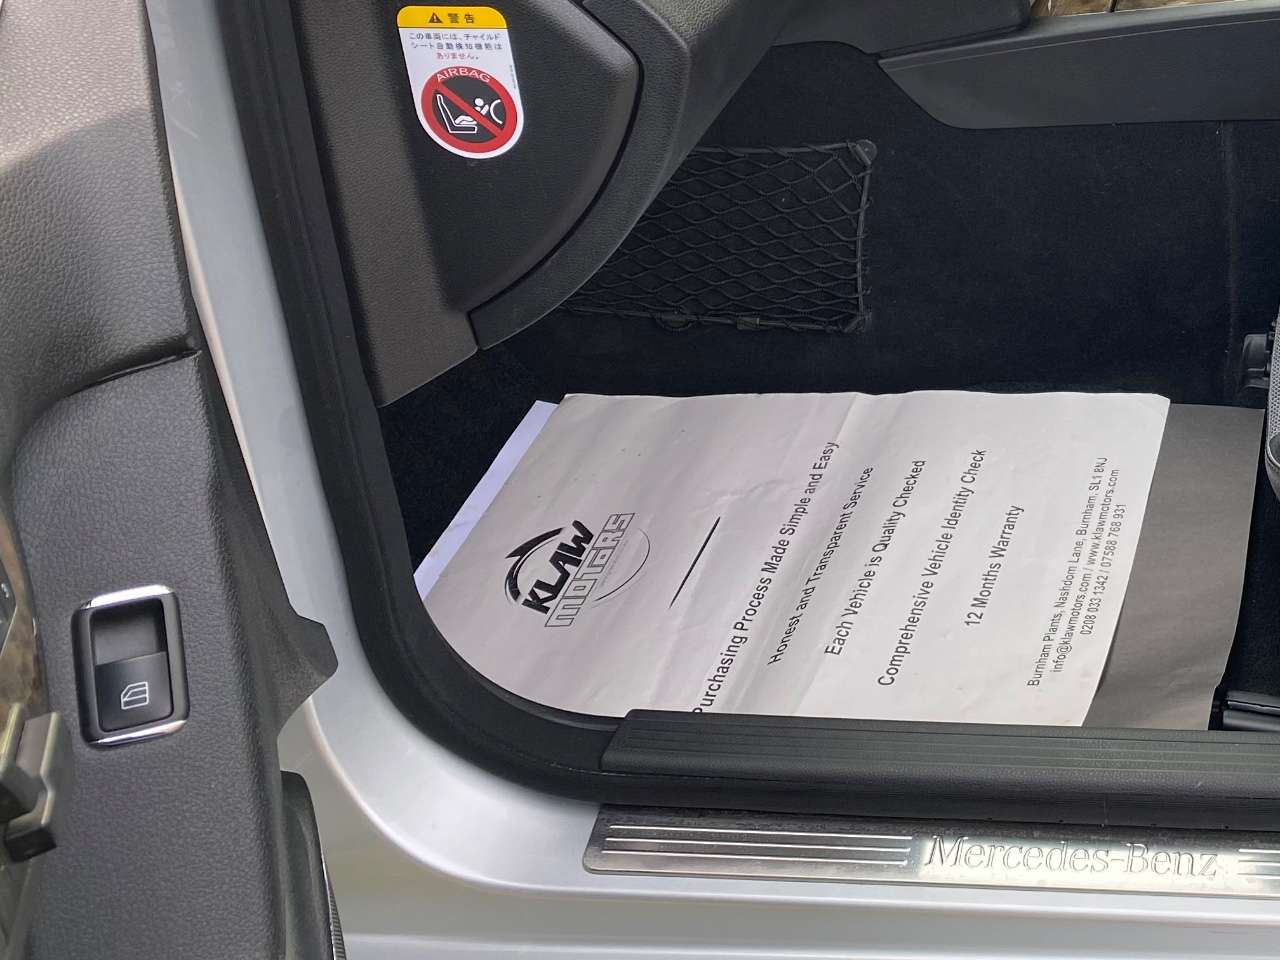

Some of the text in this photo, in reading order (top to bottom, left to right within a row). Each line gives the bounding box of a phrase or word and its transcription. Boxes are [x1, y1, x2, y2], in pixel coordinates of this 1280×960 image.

[436, 68, 491, 83] AIRBAG
[813, 442, 839, 470] Easy
[805, 474, 823, 494] and
[1089, 476, 1102, 491] SL1
[780, 497, 811, 535] Simple
[1076, 493, 1098, 536] Burnham,
[1107, 521, 1122, 537] 768
[1113, 504, 1126, 520] 931
[521, 520, 595, 615] KLAW
[761, 539, 790, 573] Made
[767, 467, 874, 665] Honest and Transparent Service
[824, 460, 926, 655] Each Vehicle is Quality Checked
[877, 449, 987, 686] Comprehensive Vehicle Identity Check
[964, 505, 1024, 626] 12 Months Warranty
[1067, 539, 1086, 563] Lane,
[1101, 540, 1118, 568] 07588
[1050, 574, 1092, 673] info@klawmotors.com
[1087, 469, 1120, 566] www.klawmotors.com
[1054, 566, 1077, 608] Nashdom
[1093, 575, 1109, 596] 1342
[733, 577, 772, 631] Process
[1087, 598, 1102, 613] 033
[1043, 610, 1065, 642] Plants,
[1080, 614, 1097, 635] 0208
[1027, 644, 1052, 686] Burnham
[923, 835, 1218, 880] Mercedes-Benz
